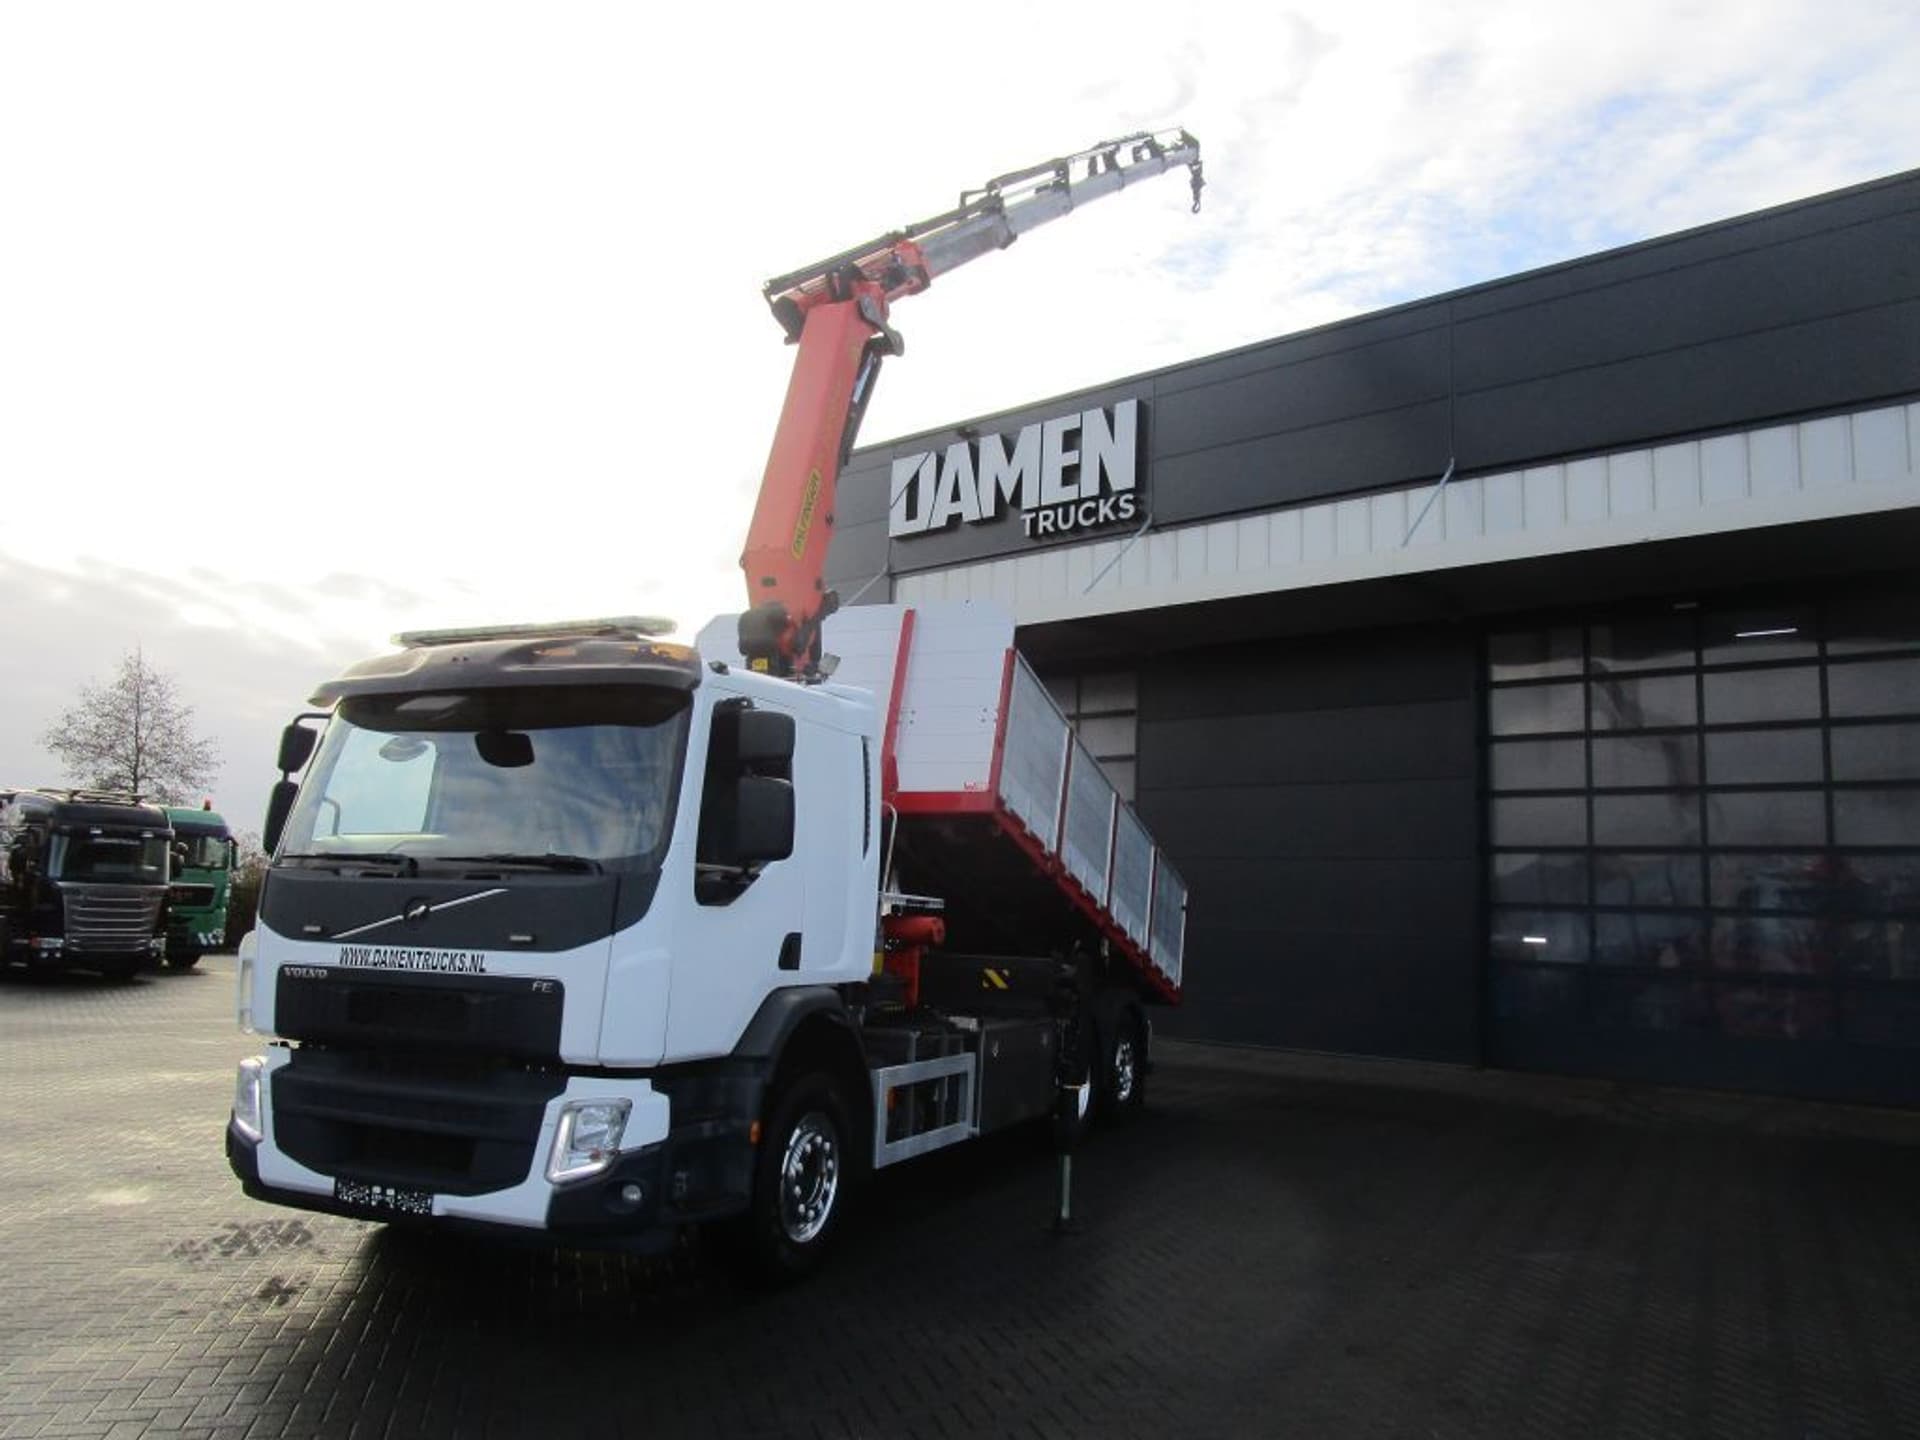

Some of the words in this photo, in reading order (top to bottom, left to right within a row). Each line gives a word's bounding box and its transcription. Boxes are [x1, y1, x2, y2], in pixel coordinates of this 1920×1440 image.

[889, 398, 1138, 538] DAMEN
[1020, 493, 1136, 537] TRUCKS
[283, 967, 328, 979] VOLVO
[339, 946, 487, 973] WWW.DAMENTRUCKS.NL
[531, 980, 553, 993] FE
